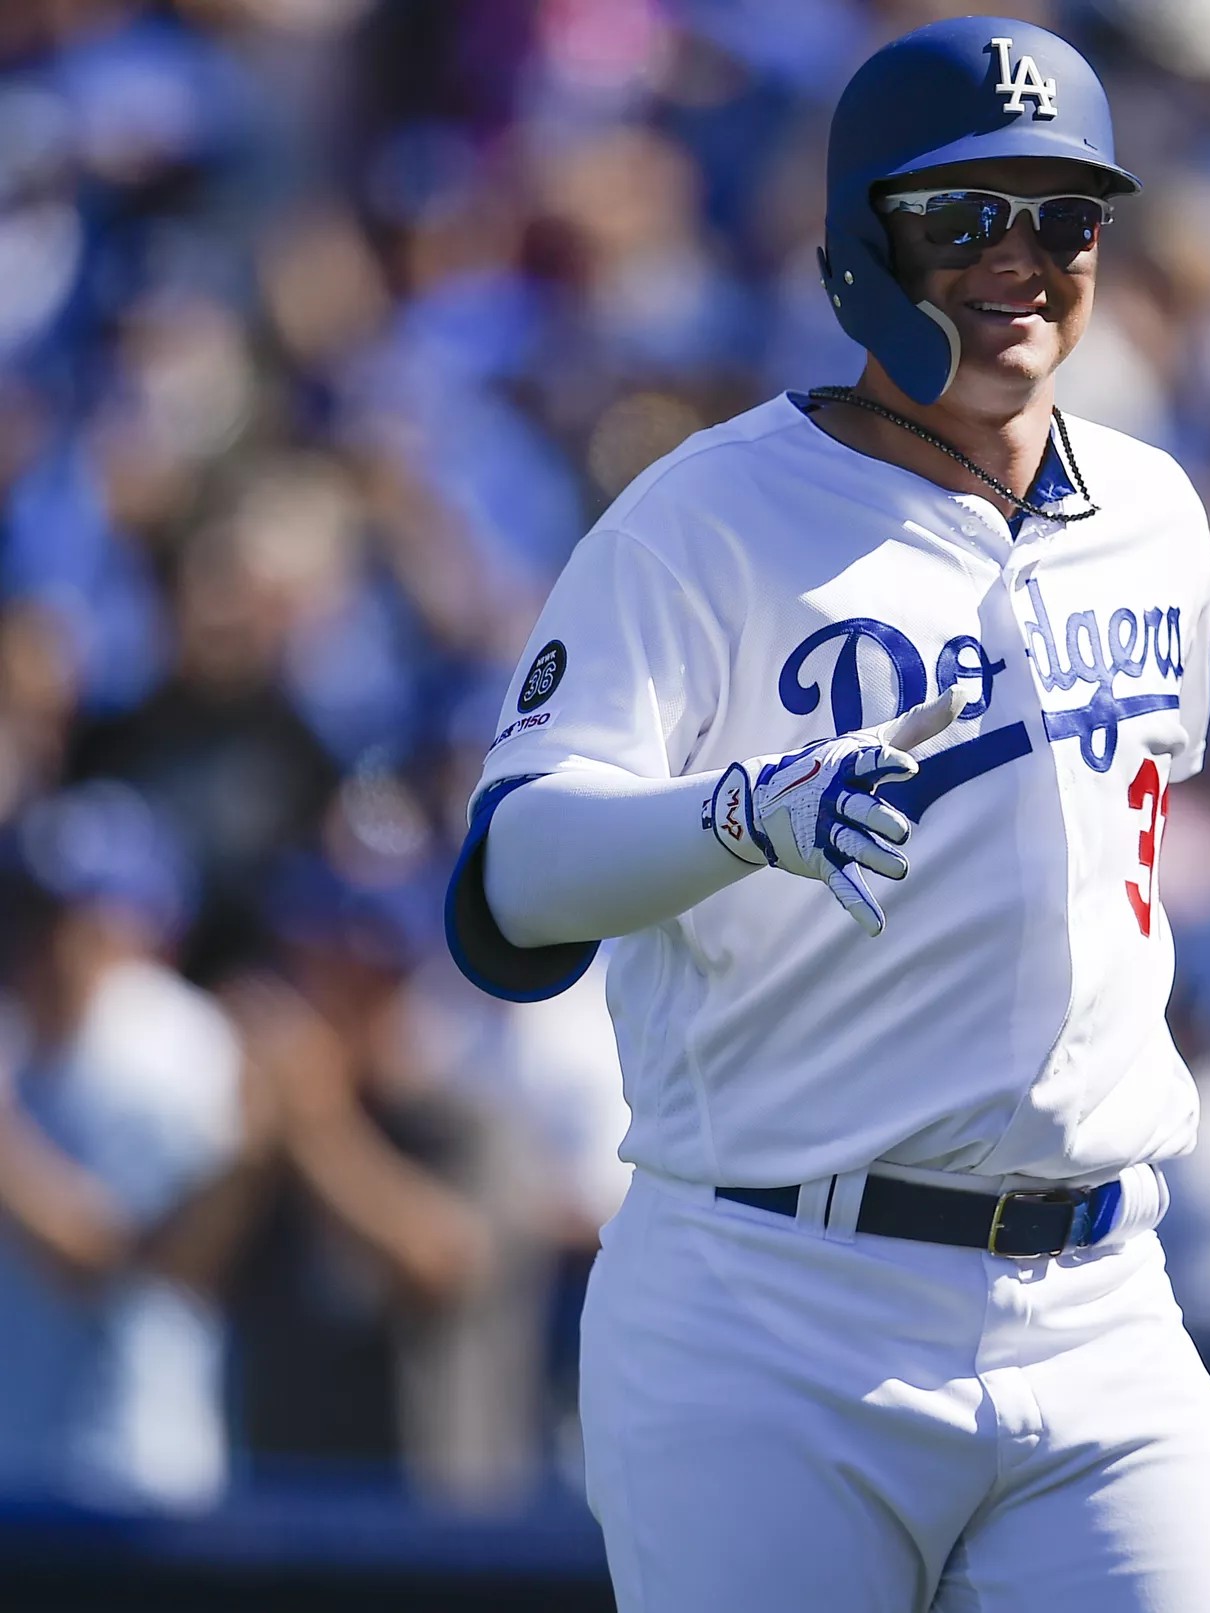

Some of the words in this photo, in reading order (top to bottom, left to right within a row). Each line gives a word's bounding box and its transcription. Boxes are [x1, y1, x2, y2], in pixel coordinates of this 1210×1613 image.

[991, 37, 1057, 117] LA
[523, 661, 557, 702] 36
[720, 788, 743, 842] MVP
